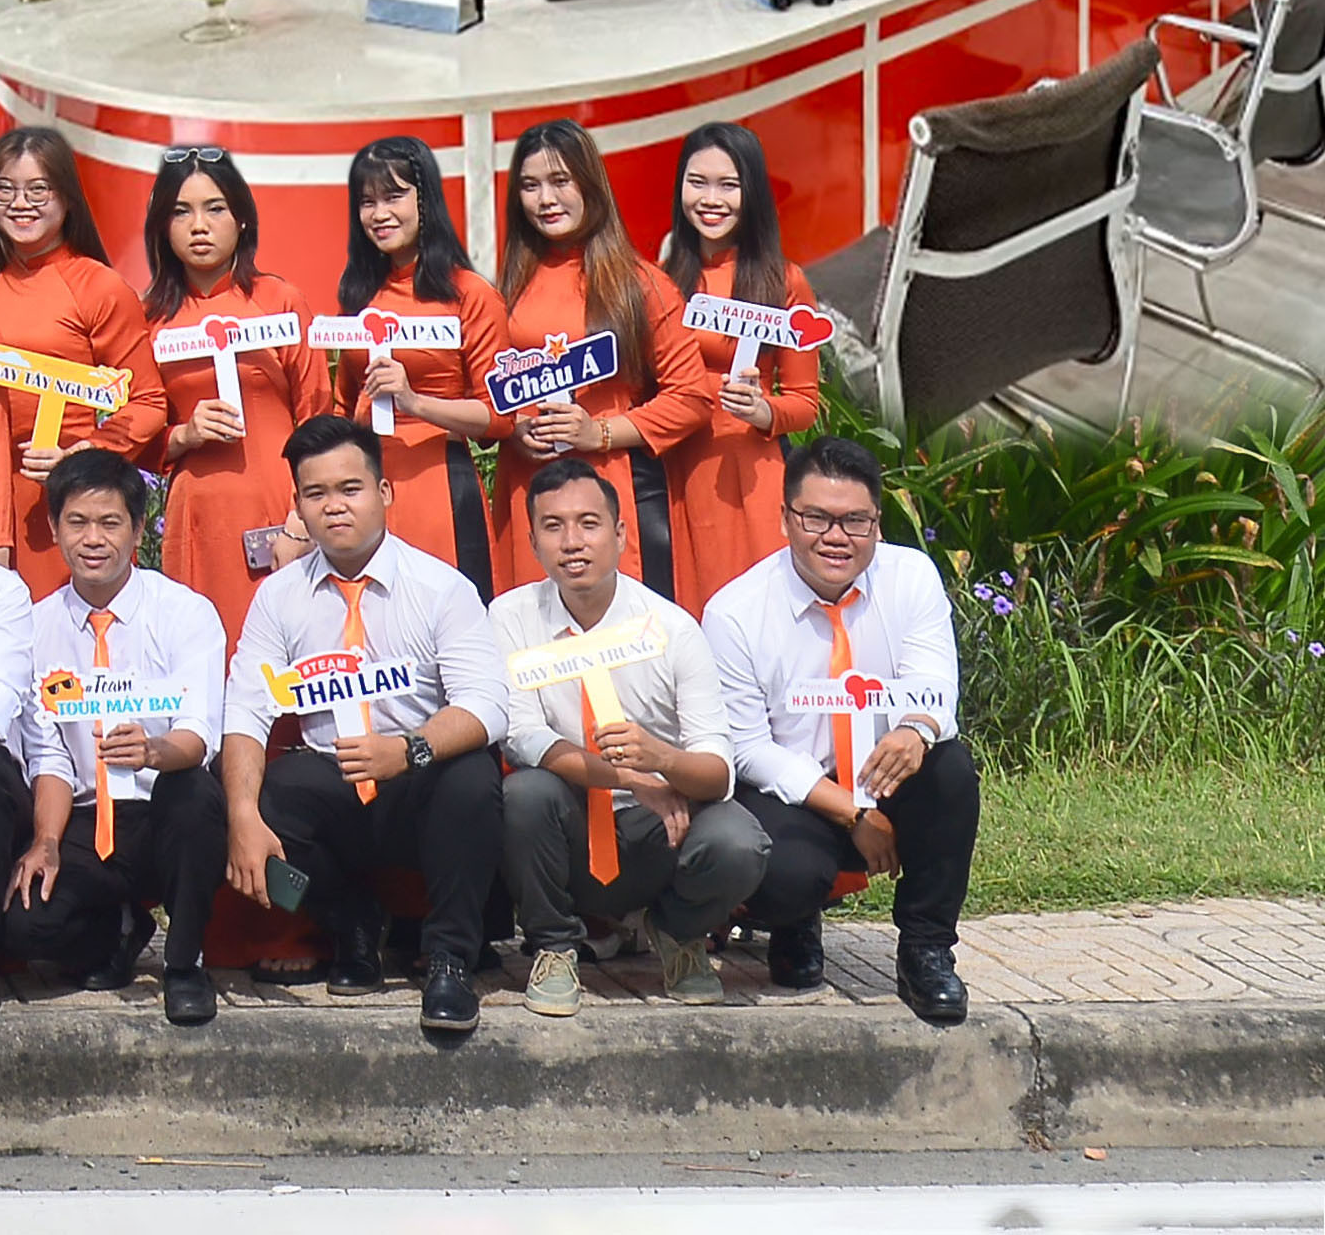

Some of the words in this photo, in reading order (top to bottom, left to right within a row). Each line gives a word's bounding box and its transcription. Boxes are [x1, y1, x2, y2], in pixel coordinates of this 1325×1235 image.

[721, 305, 782, 326] HAIDANG
[159, 338, 215, 355] HAIDANG
[228, 321, 294, 344] DUBAI
[314, 331, 372, 342] HAIDANG
[384, 325, 456, 343] JAPAN
[740, 321, 803, 346] LOAN
[504, 365, 573, 404] Châu
[582, 346, 600, 379] Á
[517, 666, 550, 685] BAY
[599, 640, 654, 664] TRUNG
[290, 671, 353, 708] THÁI
[358, 664, 411, 696] LAN
[792, 695, 854, 707] HAIDANG
[867, 686, 896, 707] HÀ
[906, 687, 943, 711] NỘI
[56, 700, 101, 716] TOUR
[149, 696, 183, 712] BAY
